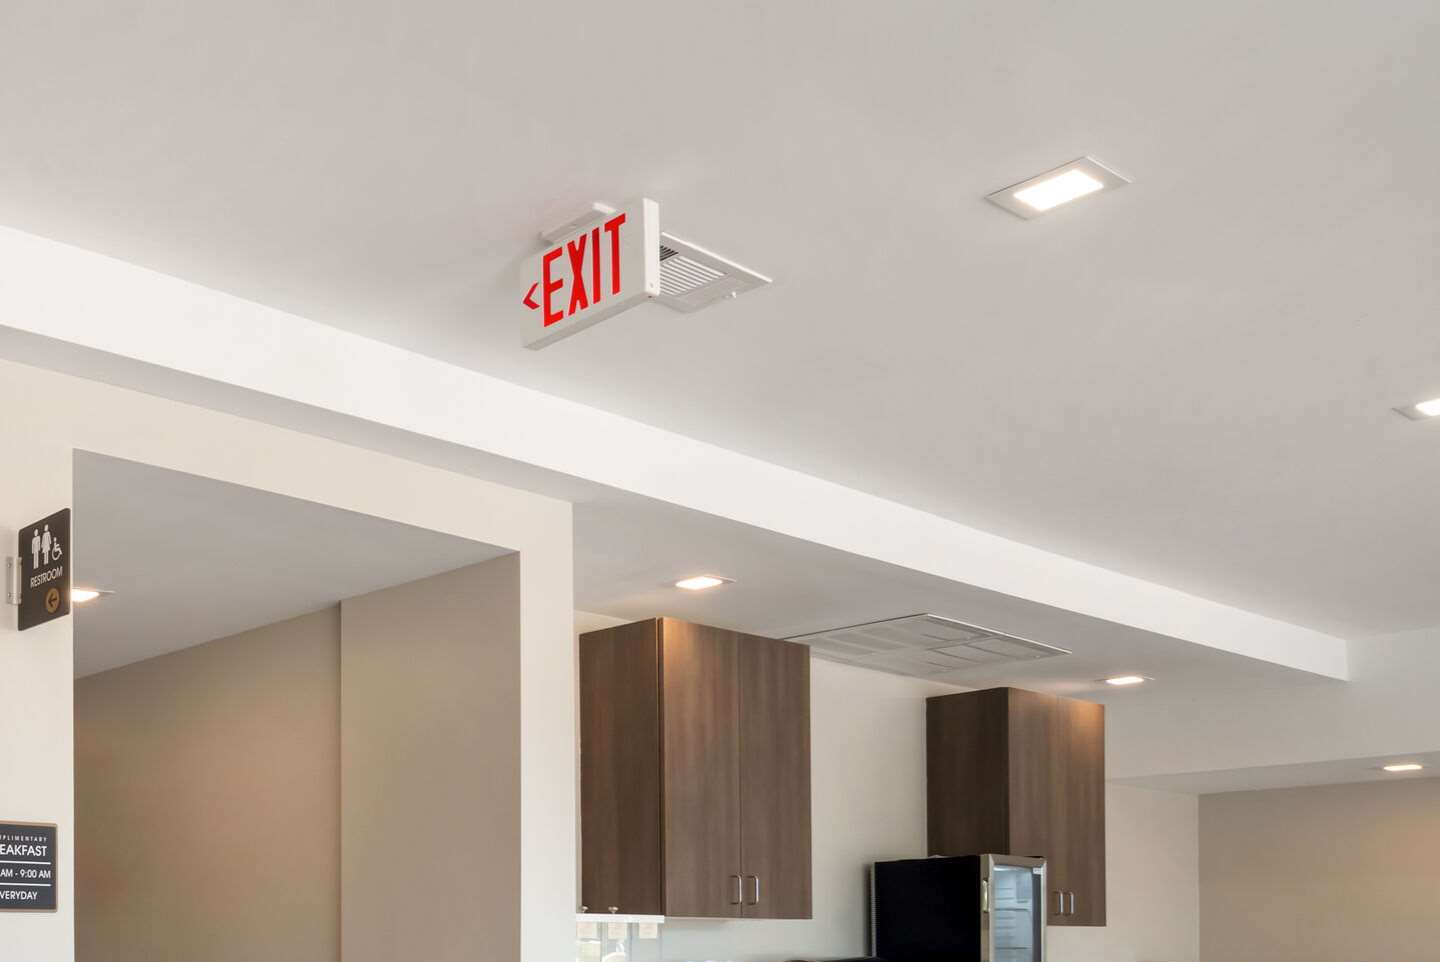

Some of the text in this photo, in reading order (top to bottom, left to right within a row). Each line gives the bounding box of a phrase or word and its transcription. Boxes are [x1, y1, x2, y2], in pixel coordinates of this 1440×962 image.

[543, 213, 626, 327] EXIT
[30, 566, 63, 588] RESTROOM
[0, 868, 13, 877] AM
[20, 869, 37, 878] 9:00
[38, 869, 51, 878] AM
